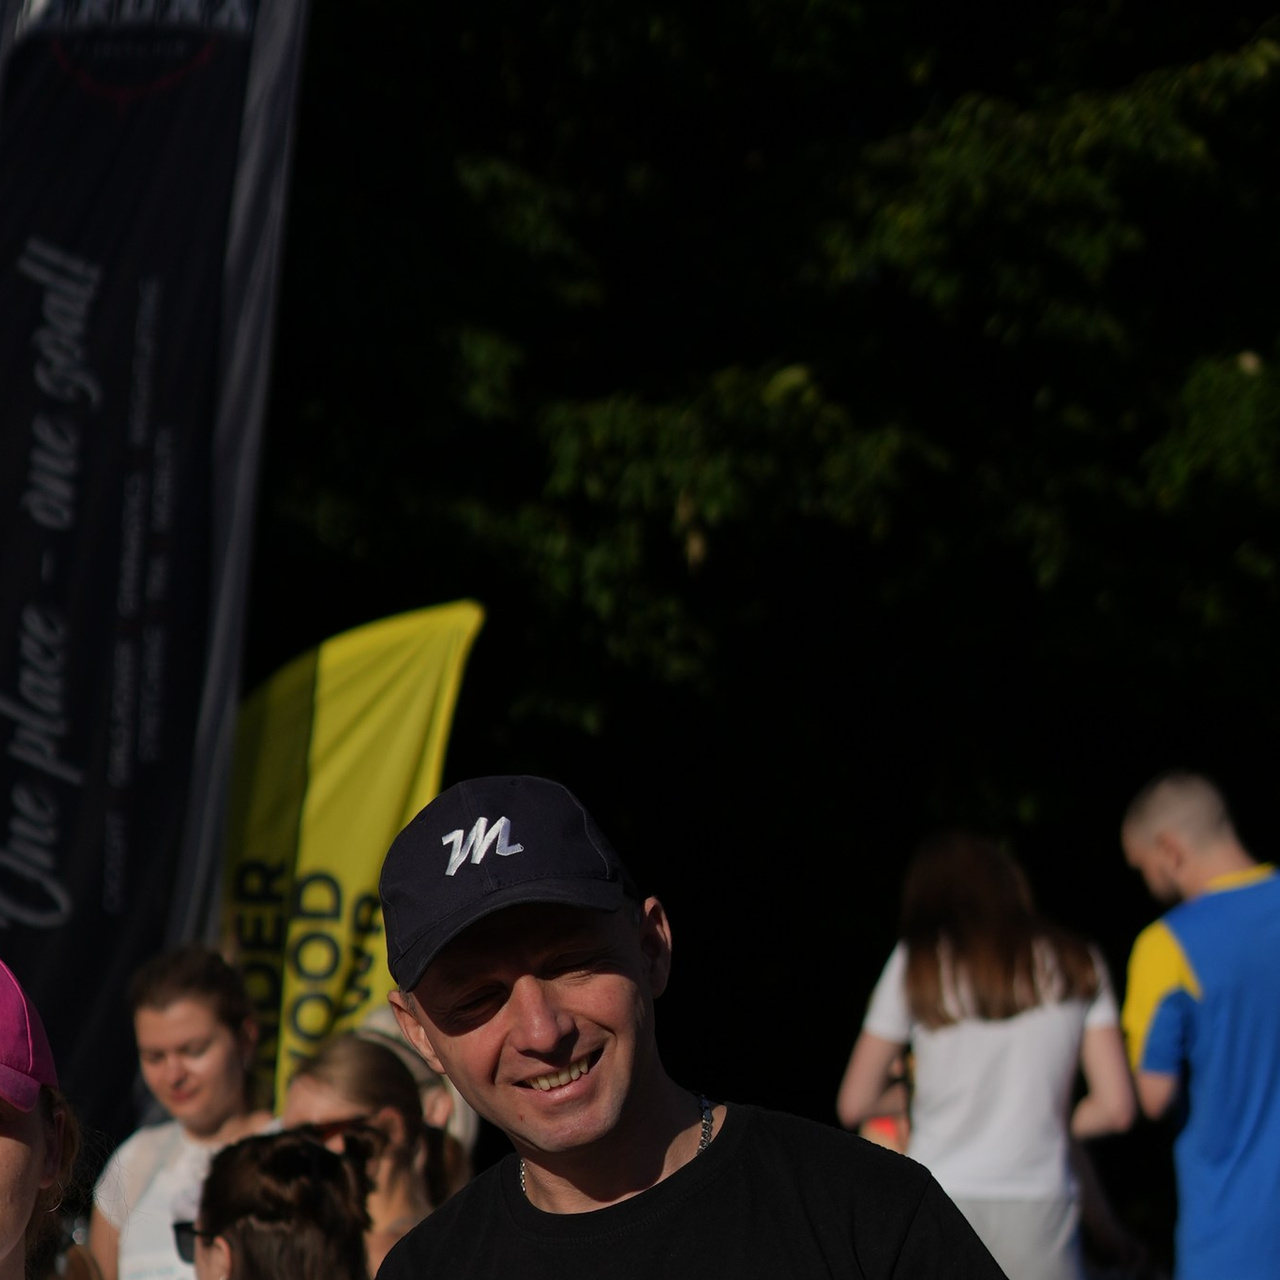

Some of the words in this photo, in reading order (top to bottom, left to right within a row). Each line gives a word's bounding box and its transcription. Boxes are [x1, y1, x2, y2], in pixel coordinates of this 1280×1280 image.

[15, 234, 104, 413] goal!
[18, 411, 82, 532] one
[289, 868, 343, 1058] OOD
